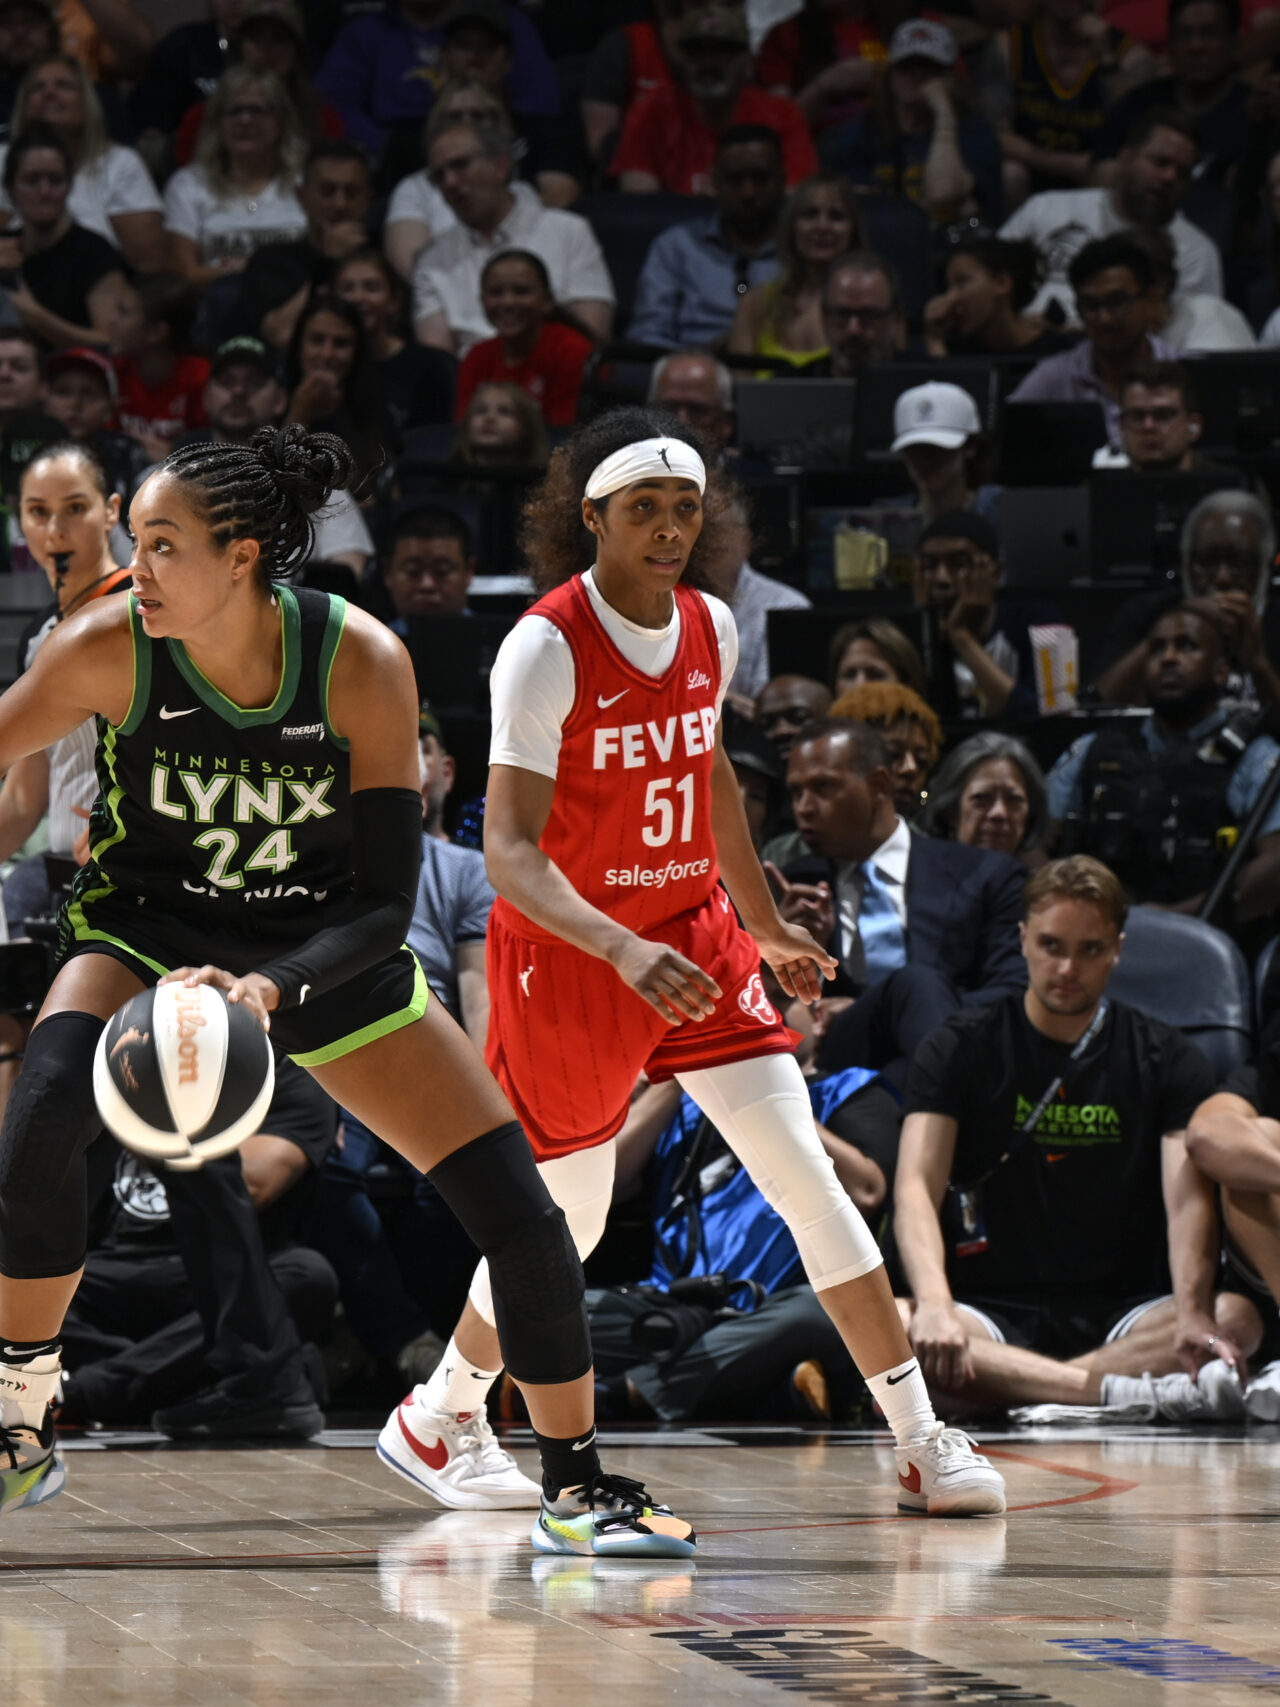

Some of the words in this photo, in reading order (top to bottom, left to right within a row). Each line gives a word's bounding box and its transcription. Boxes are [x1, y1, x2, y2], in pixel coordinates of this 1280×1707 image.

[687, 669, 711, 690] Lilly
[155, 746, 335, 778] MINNESOTA
[593, 706, 715, 769] FEVER
[151, 762, 336, 825] LYNX
[642, 773, 694, 847] 51
[192, 828, 298, 890] 24
[604, 858, 710, 888] salesforce
